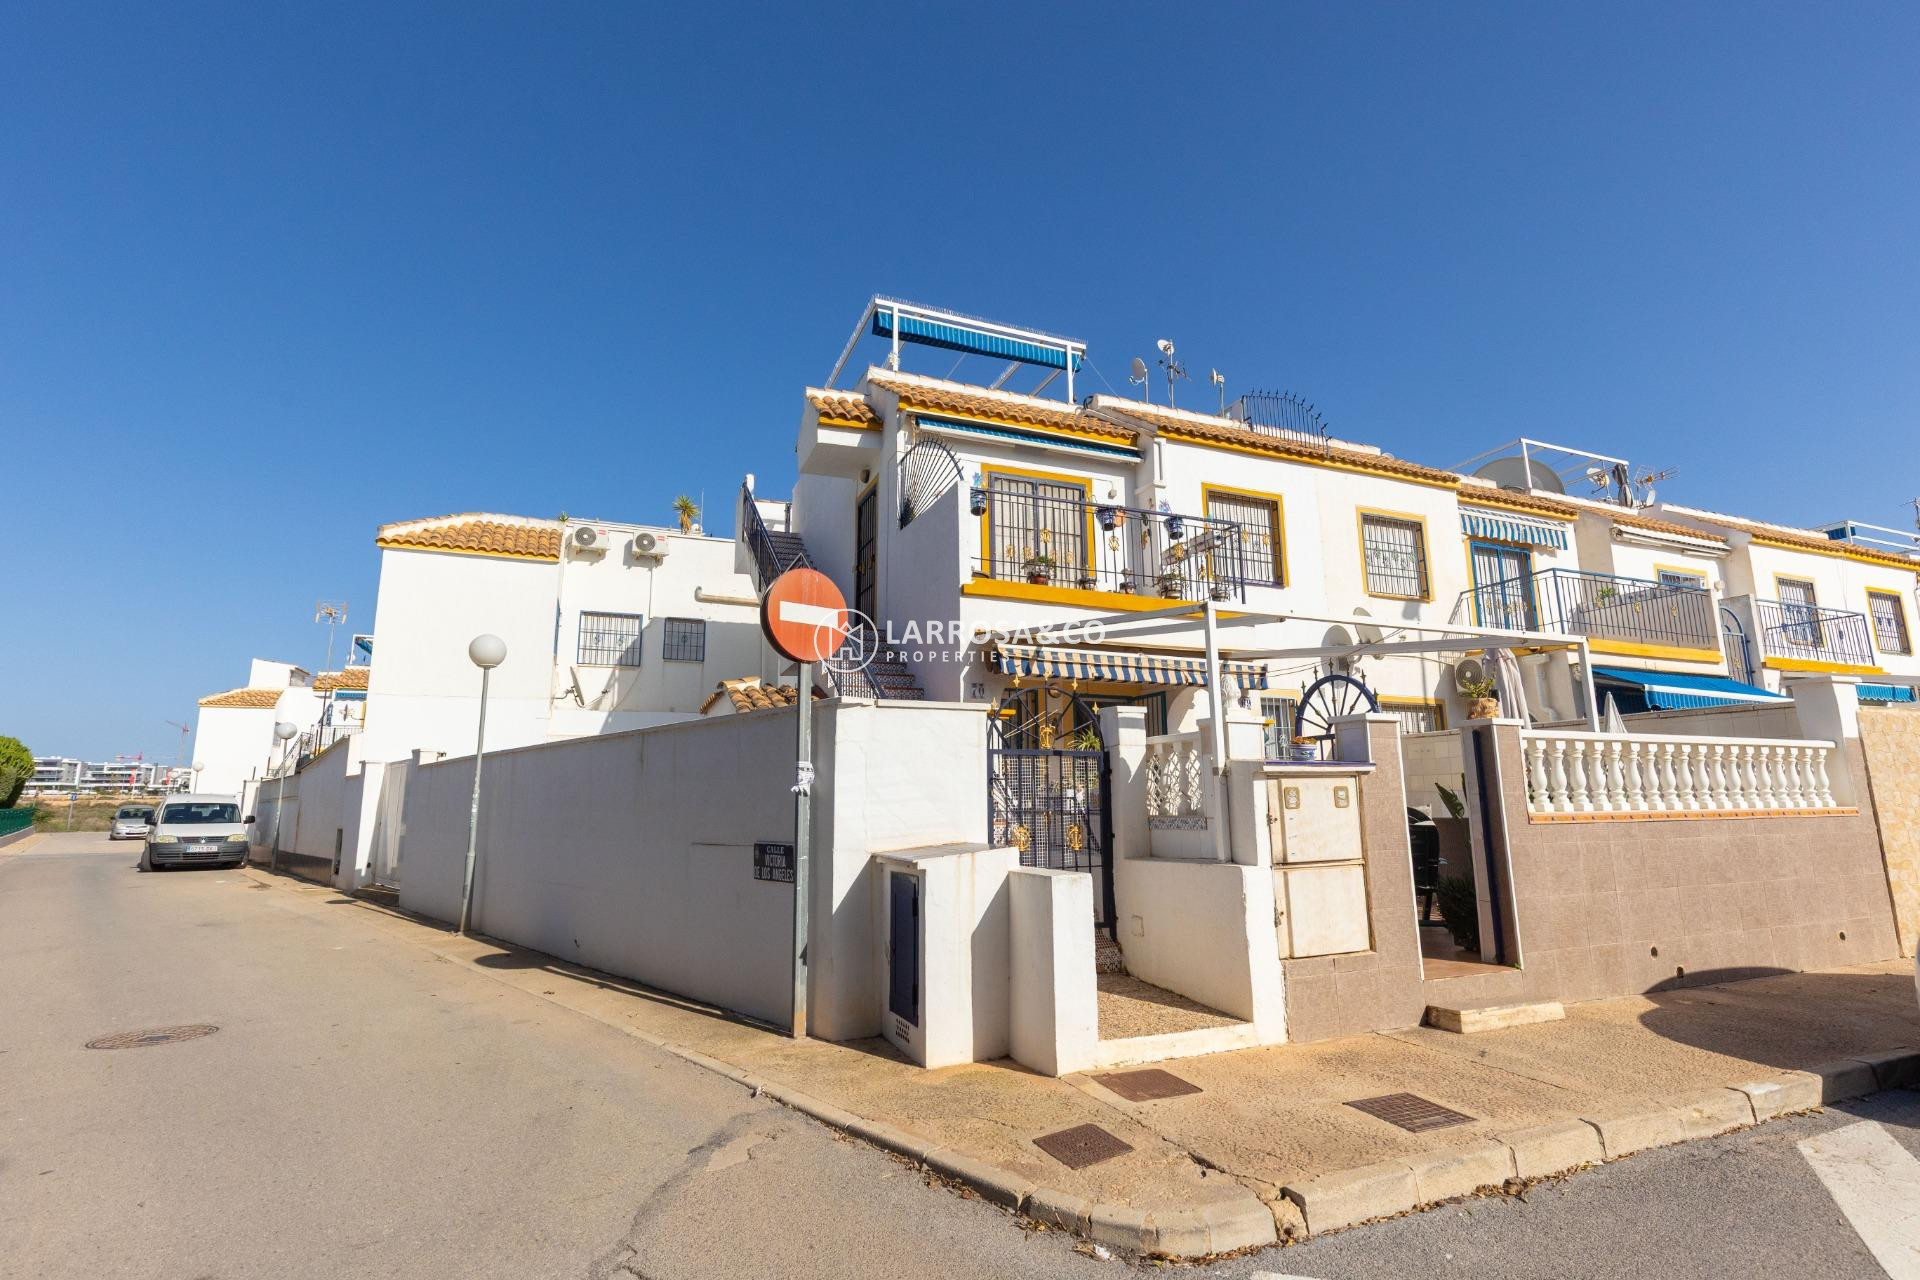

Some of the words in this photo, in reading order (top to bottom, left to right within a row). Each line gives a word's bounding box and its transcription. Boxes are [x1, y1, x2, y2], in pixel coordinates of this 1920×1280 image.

[766, 845, 784, 854] CALLE
[764, 854, 786, 867] VICTORIA
[754, 865, 760, 878] DE
[761, 867, 770, 880] LOS
